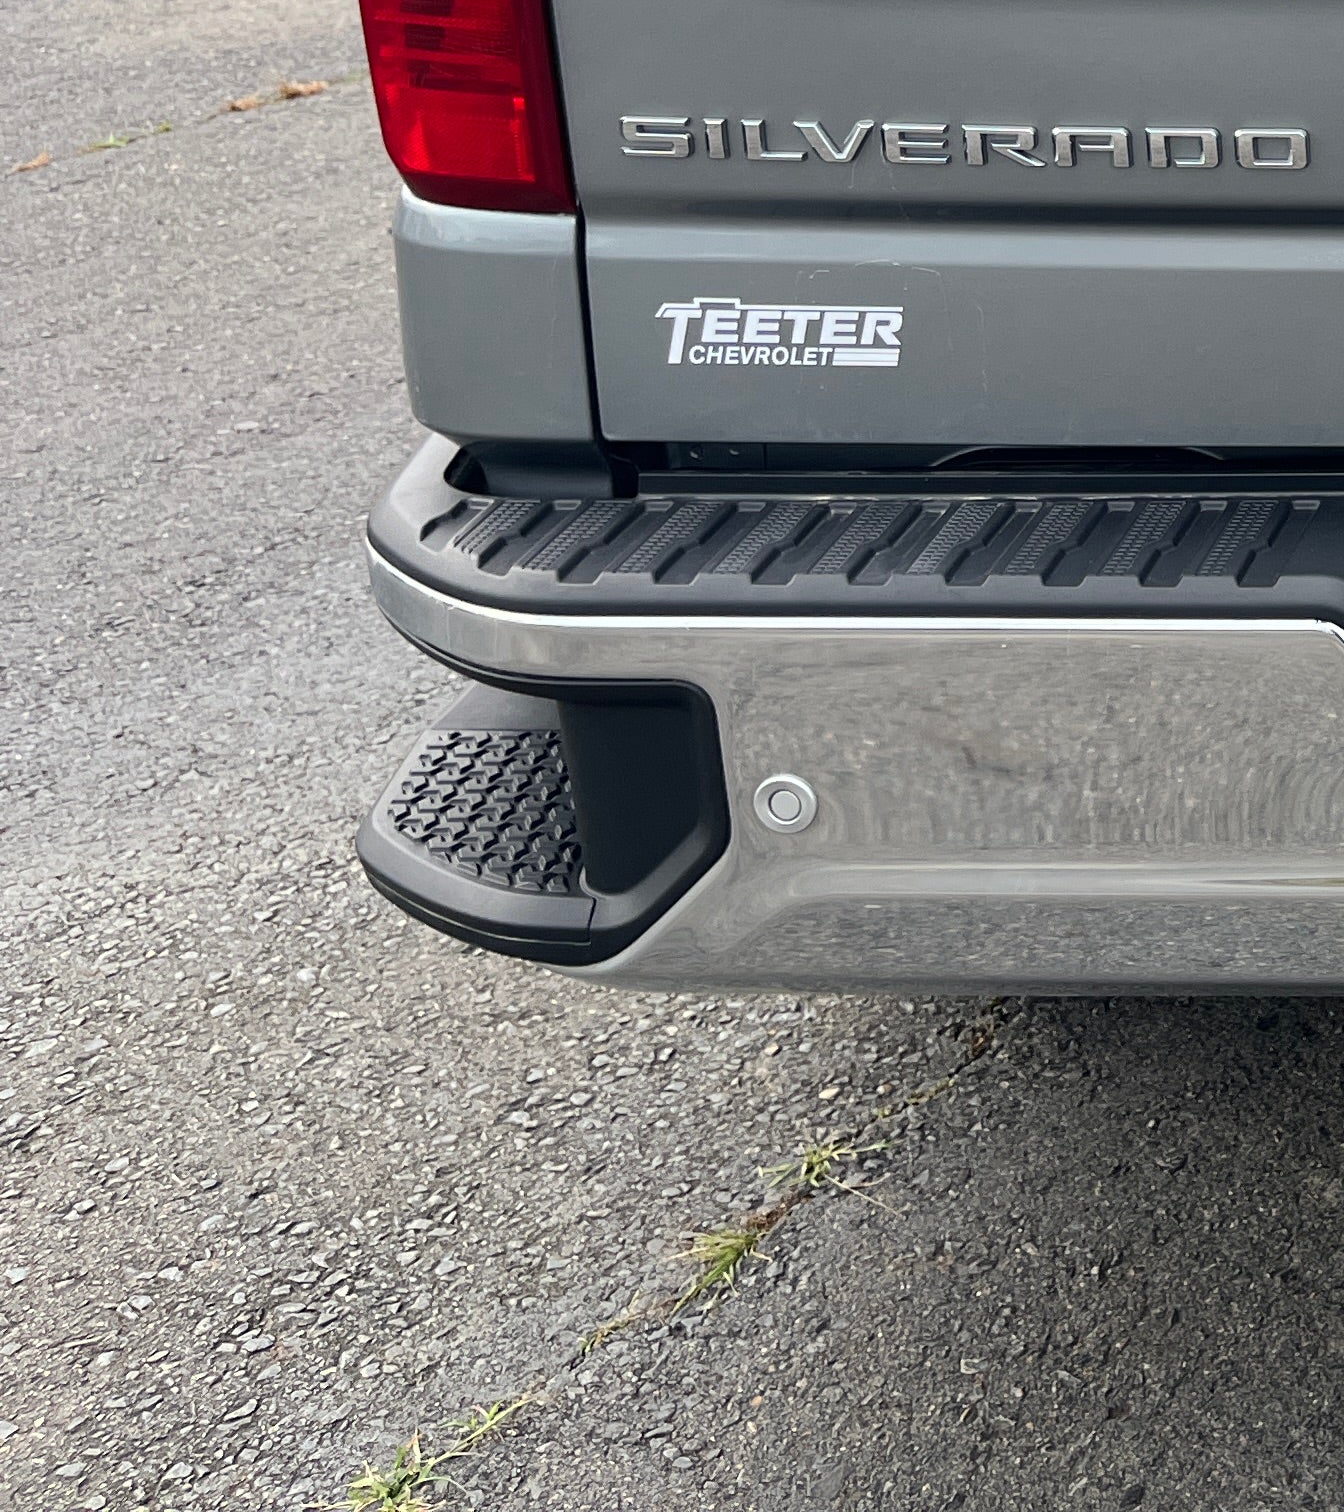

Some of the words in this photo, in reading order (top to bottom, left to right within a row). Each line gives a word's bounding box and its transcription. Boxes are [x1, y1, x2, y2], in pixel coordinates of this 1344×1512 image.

[619, 115, 1311, 170] SILVERADO
[661, 305, 904, 365] TEETER
[688, 345, 834, 367] CHEVROLET
